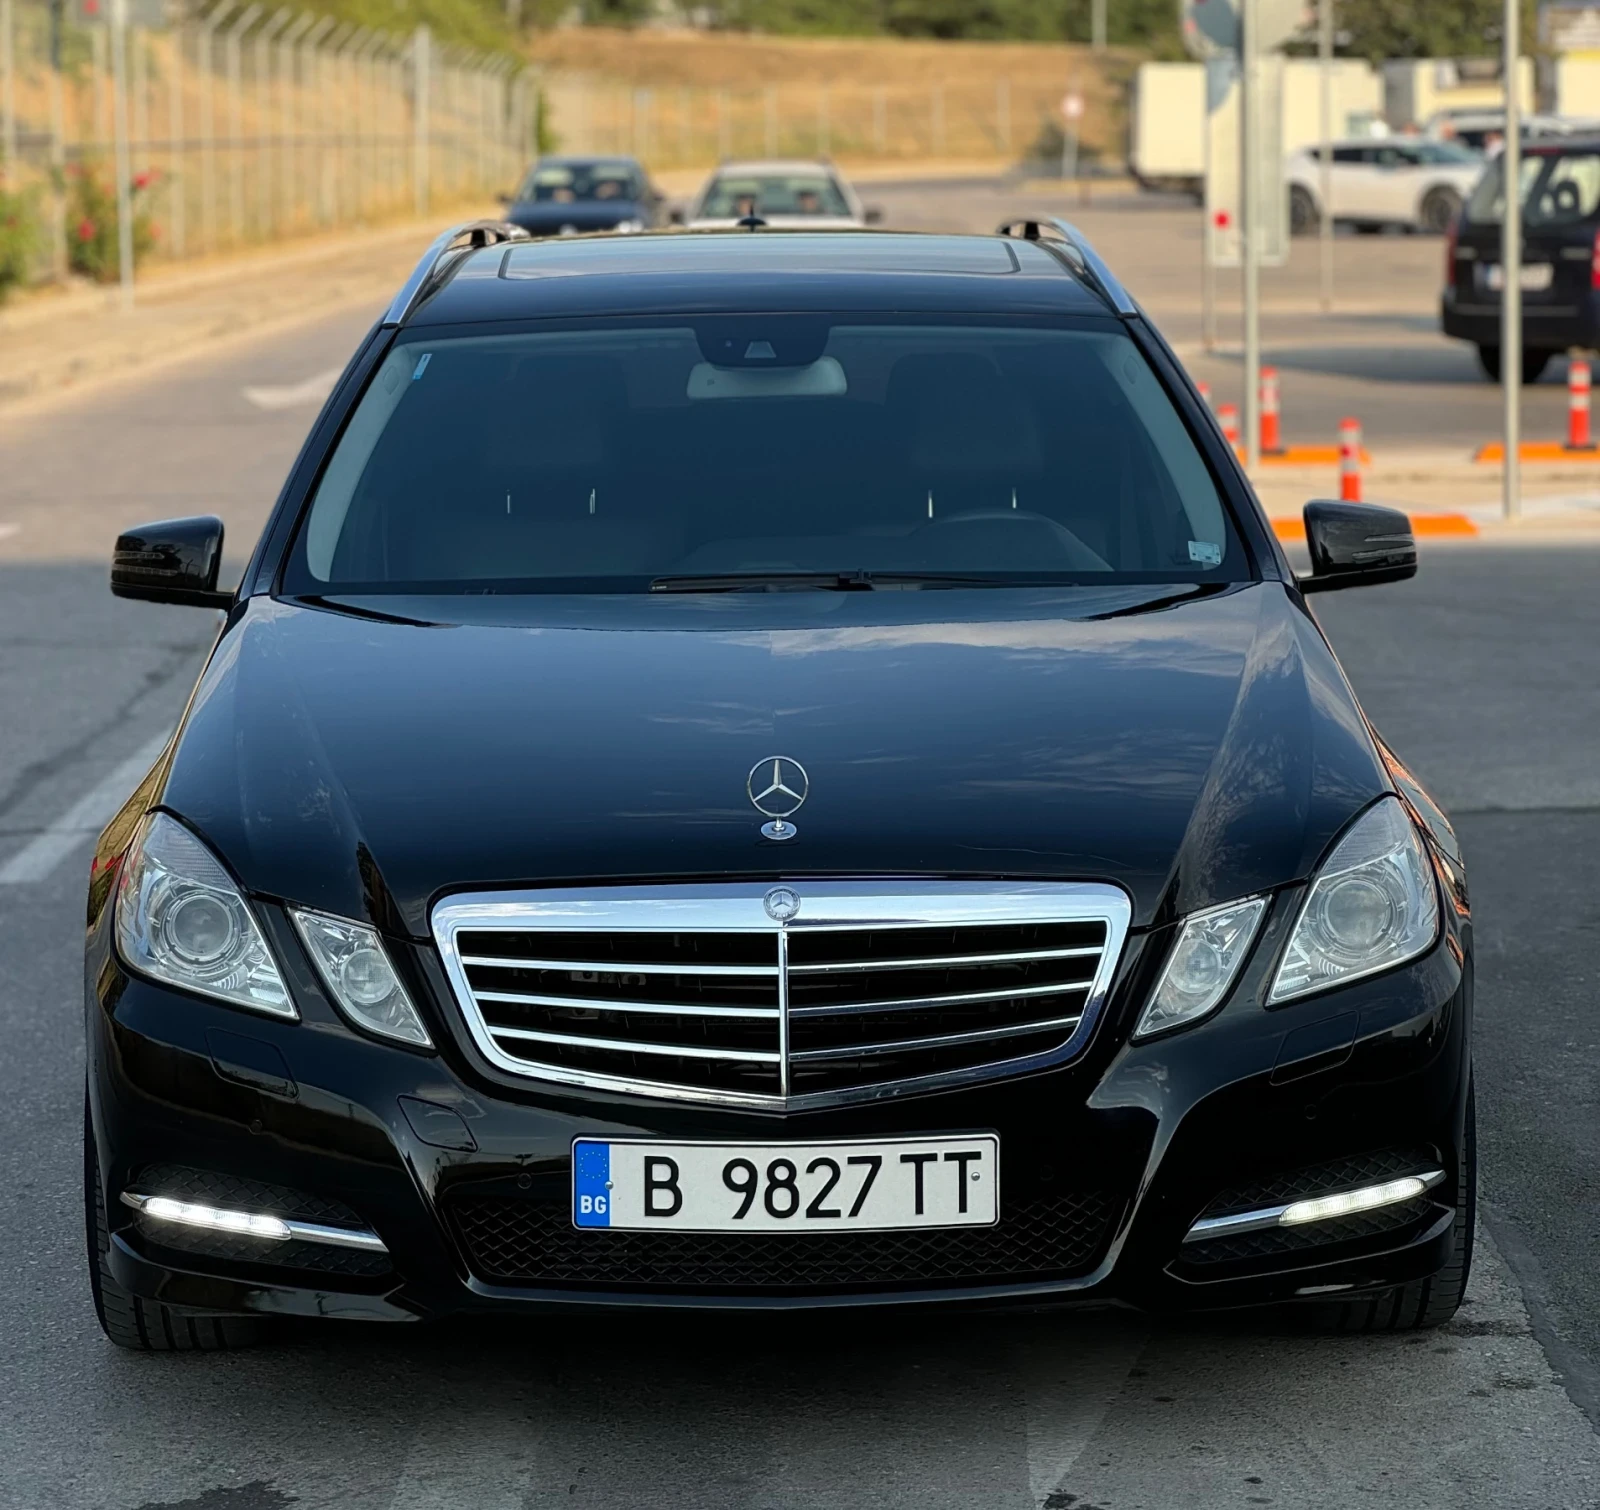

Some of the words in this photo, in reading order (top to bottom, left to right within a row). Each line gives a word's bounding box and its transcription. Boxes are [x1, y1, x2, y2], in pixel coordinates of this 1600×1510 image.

[580, 1195, 607, 1214] BG
[644, 1156, 682, 1217] B
[722, 1156, 882, 1219] 9827
[900, 1152, 981, 1215] TT
